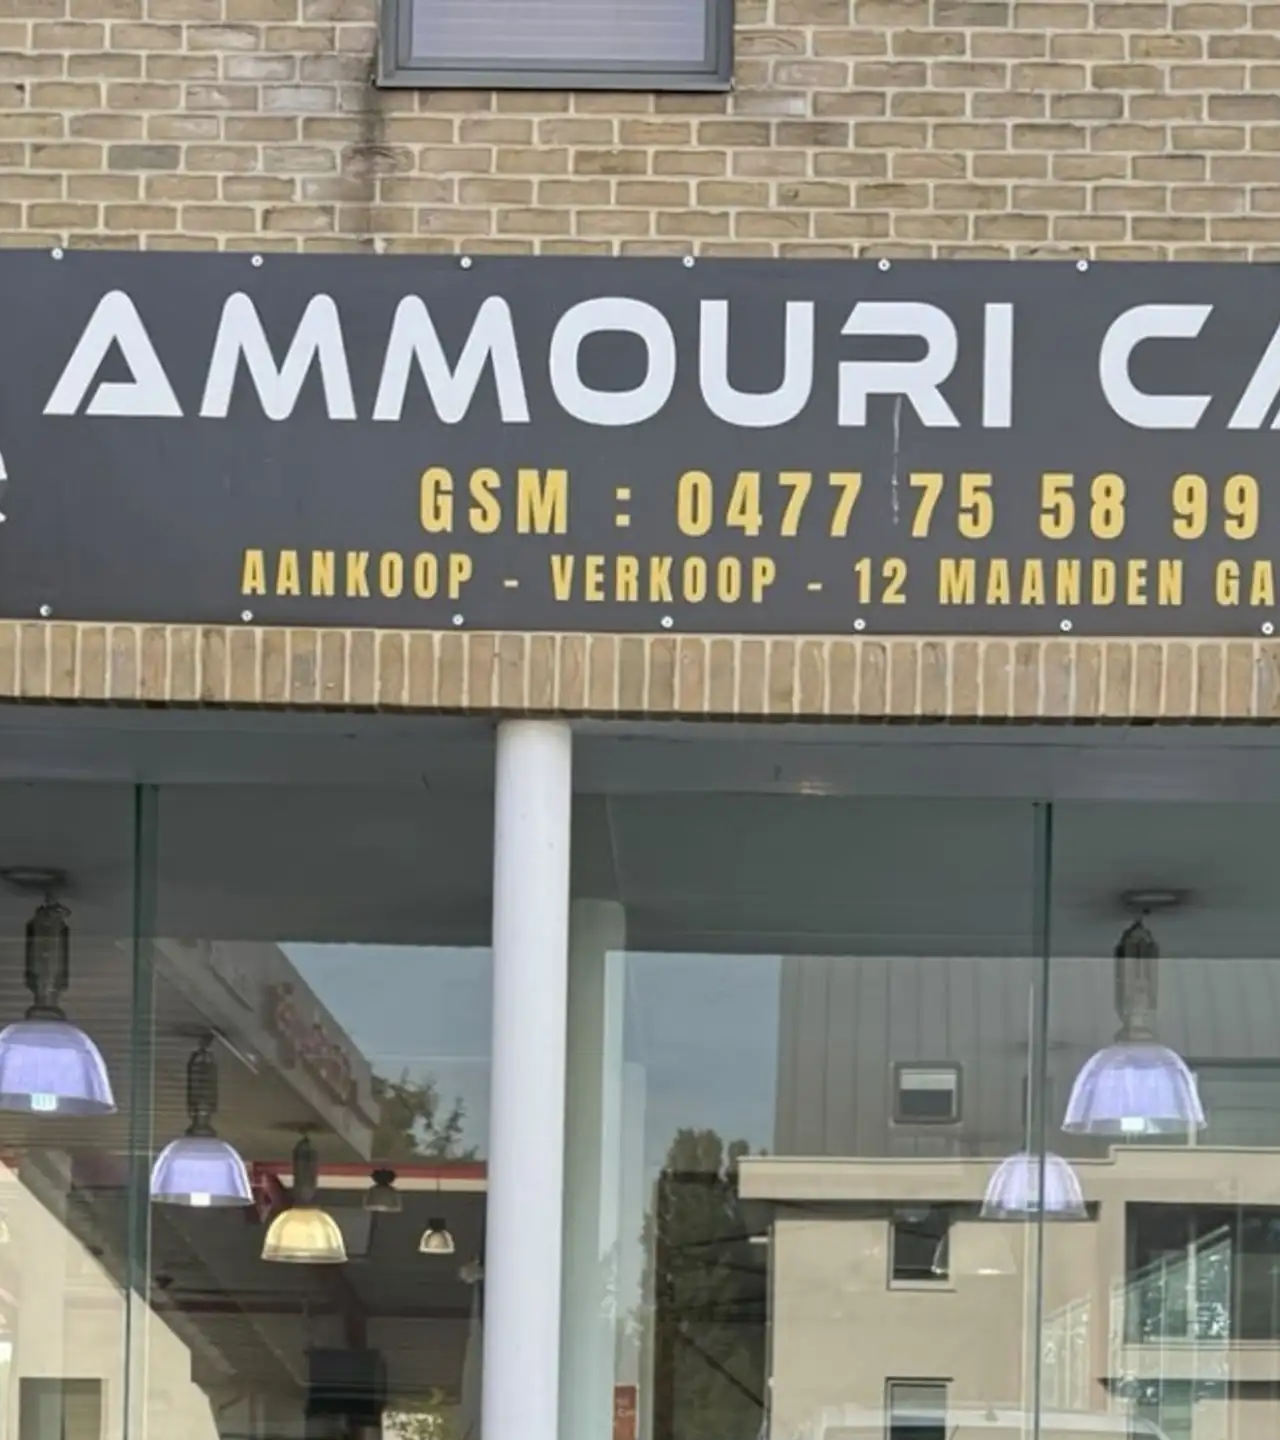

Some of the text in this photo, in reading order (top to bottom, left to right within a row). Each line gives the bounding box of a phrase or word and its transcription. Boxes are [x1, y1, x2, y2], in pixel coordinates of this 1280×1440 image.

[43, 289, 1014, 430] AMMOURI
[419, 466, 1261, 541] GSM : 0477 75 58 99
[241, 549, 473, 600] AANKOOP
[551, 553, 776, 603] VERKOOP
[854, 557, 907, 604] 12
[938, 556, 1182, 607] MAANDEN
